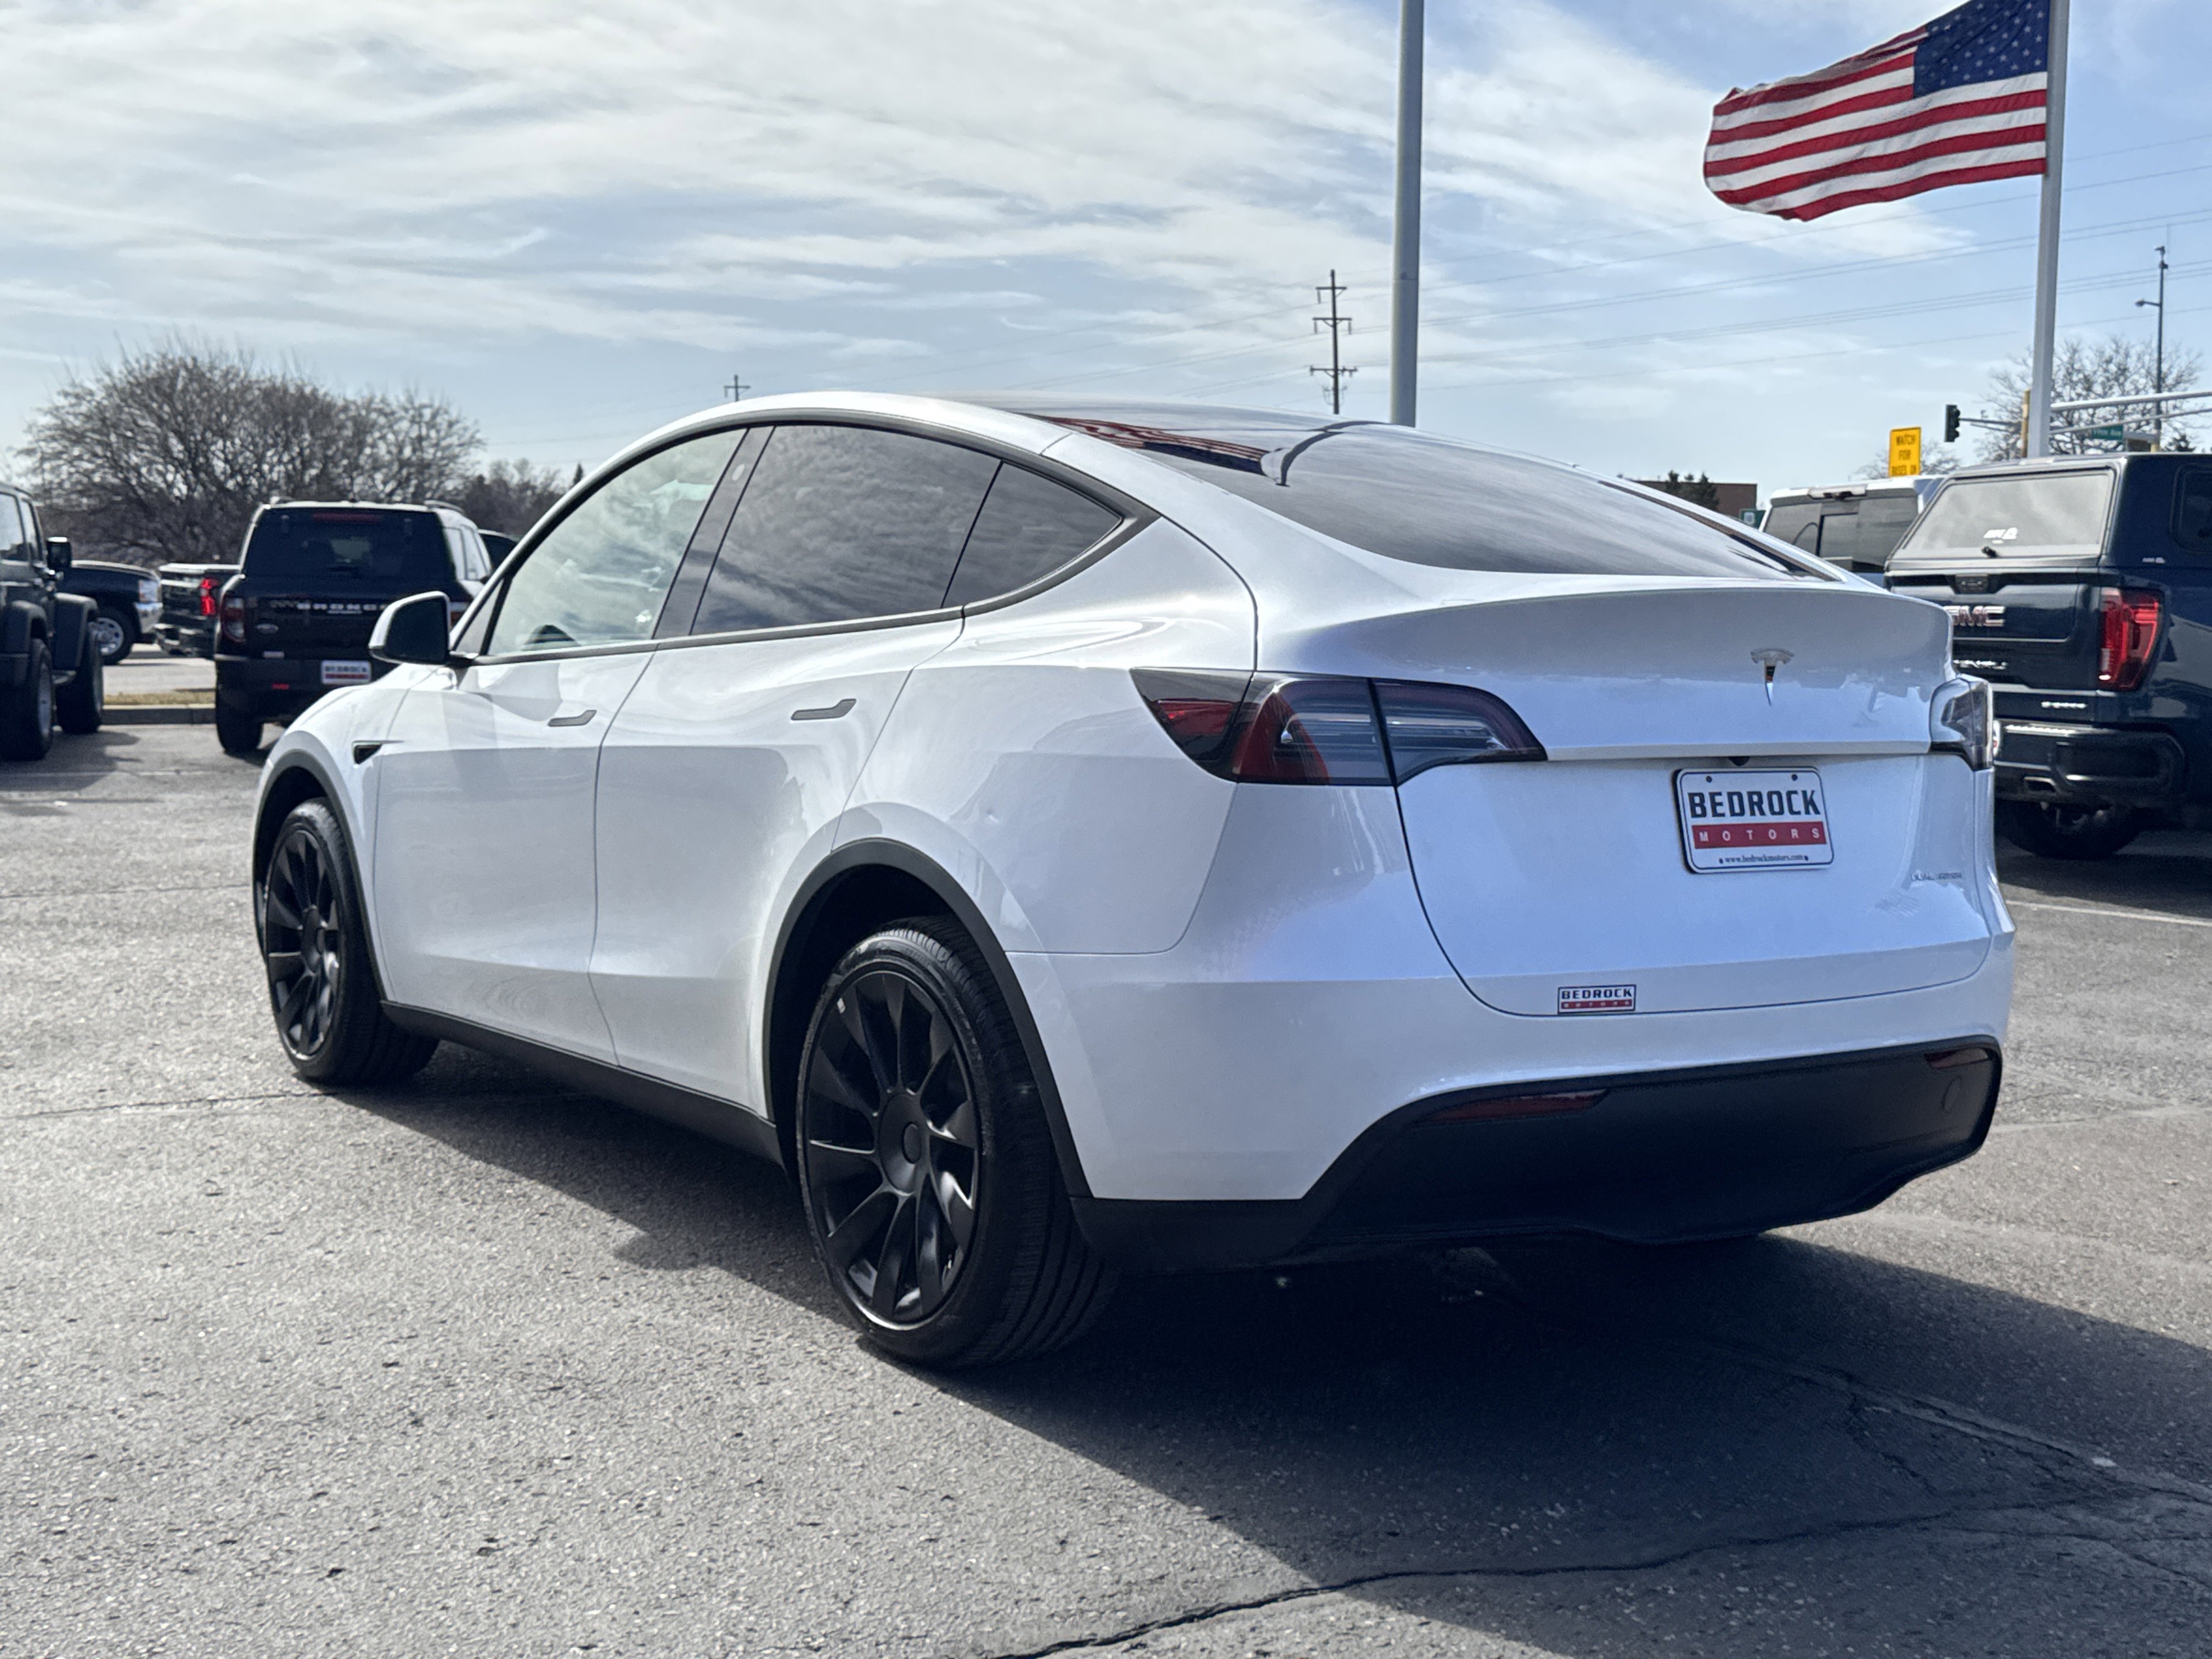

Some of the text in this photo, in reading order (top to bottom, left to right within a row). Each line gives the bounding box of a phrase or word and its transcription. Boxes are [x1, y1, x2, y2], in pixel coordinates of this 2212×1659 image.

[1899, 449, 1911, 460] FOR
[1687, 790, 1821, 818] BEDROCK
[1699, 828, 1820, 842] MOTORS
[1725, 854, 1804, 864] www.bedrockmotors.com
[1561, 988, 1632, 999] BEDROCK
